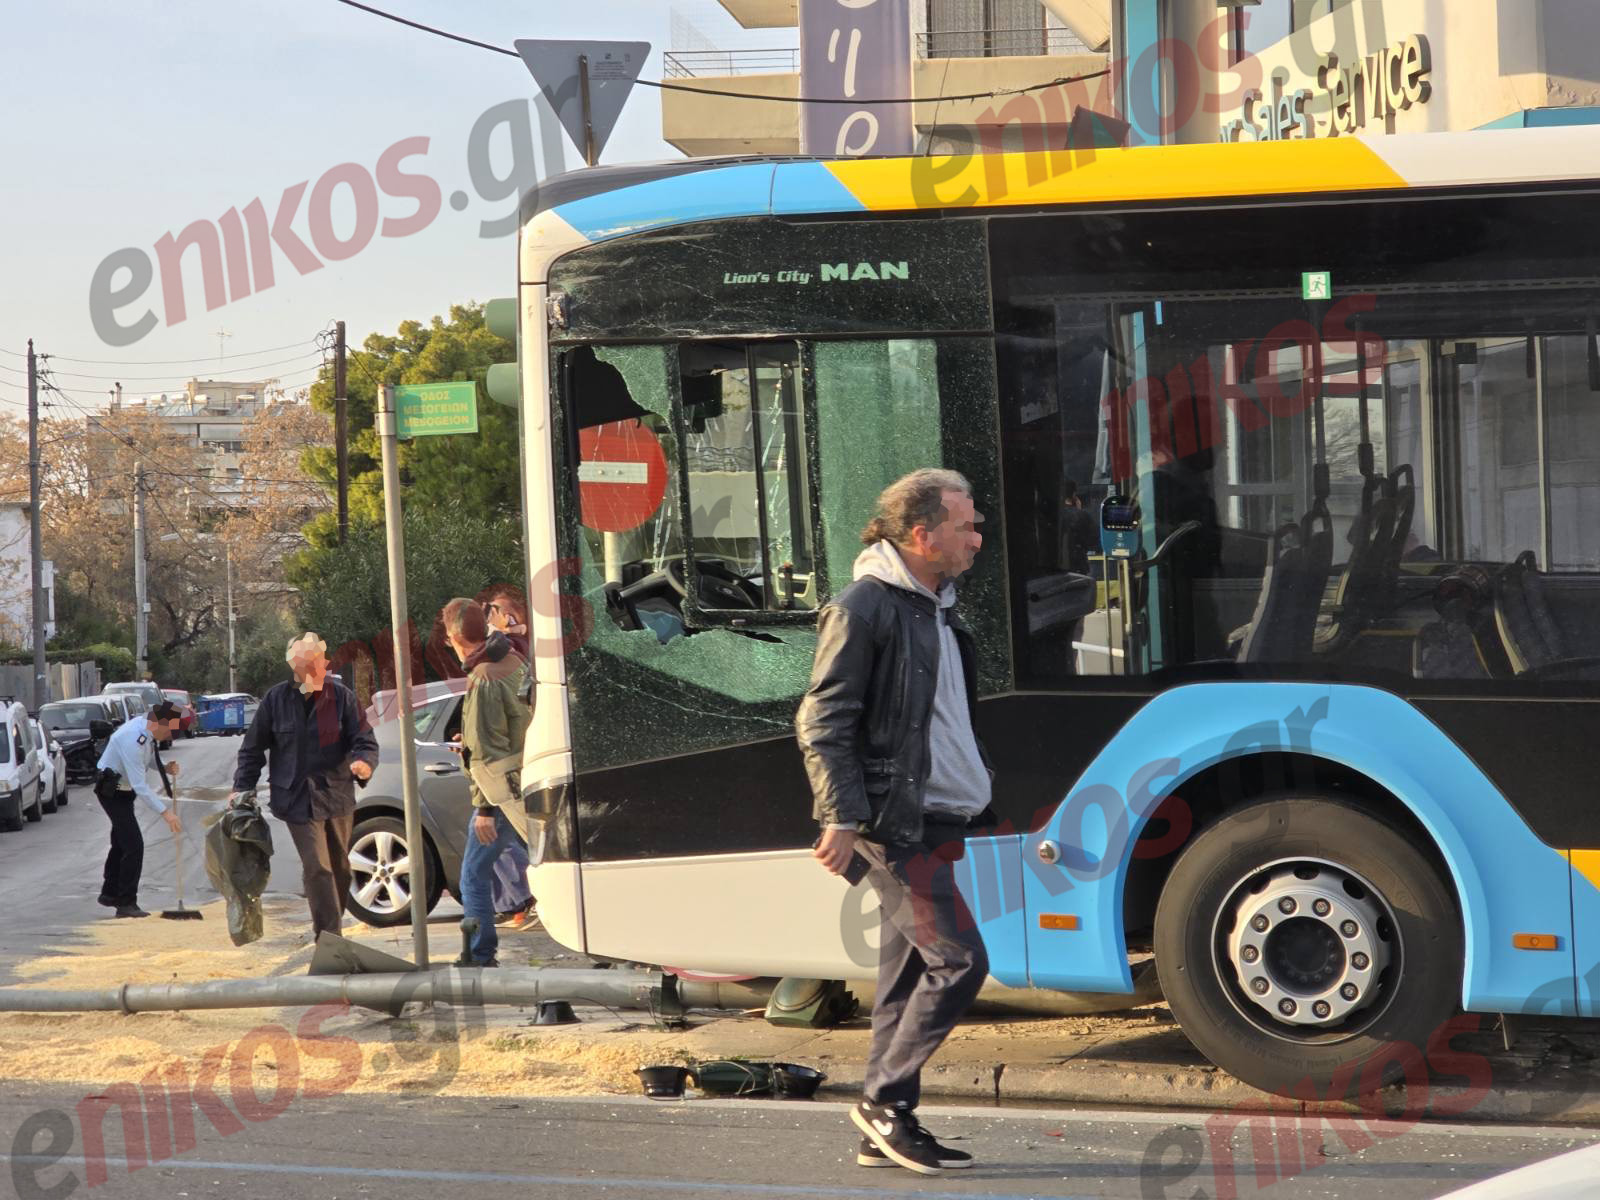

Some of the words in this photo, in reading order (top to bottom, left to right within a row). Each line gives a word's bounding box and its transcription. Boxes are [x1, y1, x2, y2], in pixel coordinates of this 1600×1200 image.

[1242, 76, 1314, 141] Sales
[1315, 33, 1432, 138] Service
[723, 272, 770, 284] Lion's
[777, 270, 810, 285] City
[820, 261, 909, 282] MAN
[420, 390, 450, 401] ΟΔΟΣ
[403, 402, 468, 415] ΜΕΣΟΓΕΙΩΝ
[404, 415, 469, 427] MESOGEION
